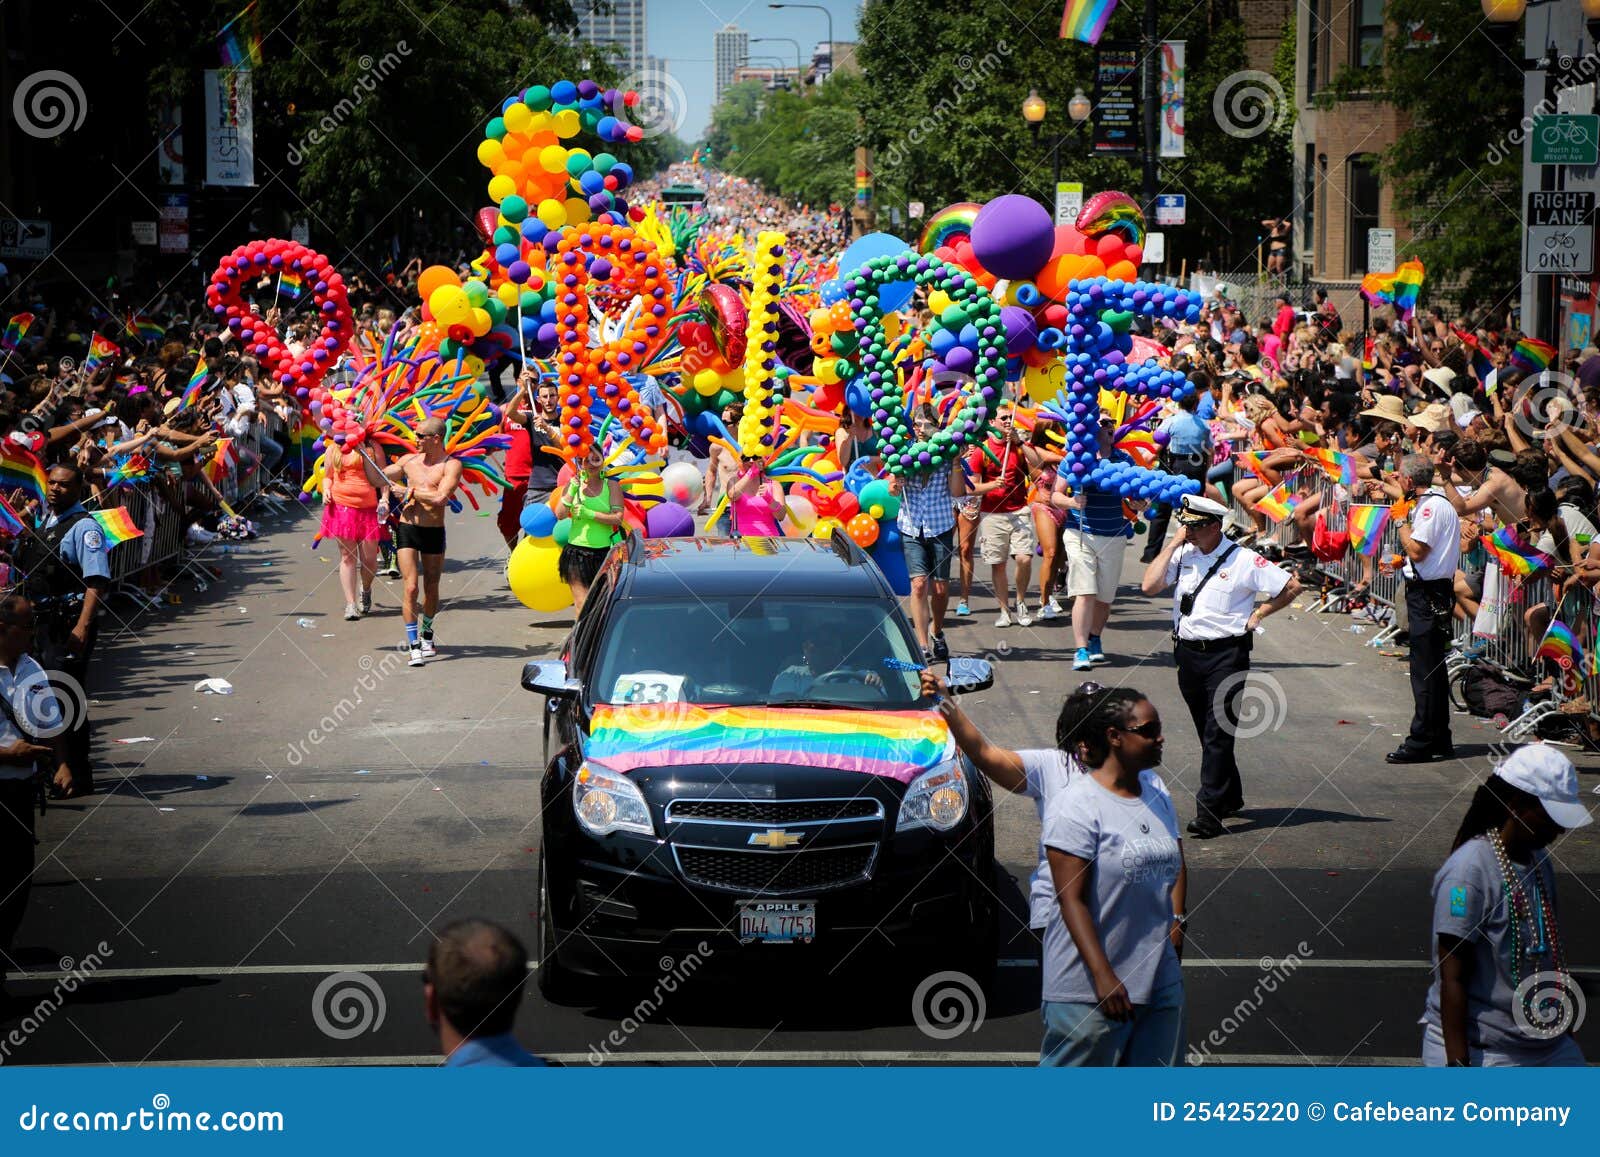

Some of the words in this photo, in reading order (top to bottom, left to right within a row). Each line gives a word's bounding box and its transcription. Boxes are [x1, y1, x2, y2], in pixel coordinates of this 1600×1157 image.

[219, 126, 239, 168] FEST
[1534, 193, 1589, 209] RIGHT
[1060, 206, 1079, 218] 20
[1535, 209, 1585, 225] LANE
[1539, 253, 1580, 268] ONLY
[624, 682, 668, 703] 83
[756, 903, 800, 911] APPLE
[742, 916, 769, 936] D44
[779, 916, 814, 936] 7753
